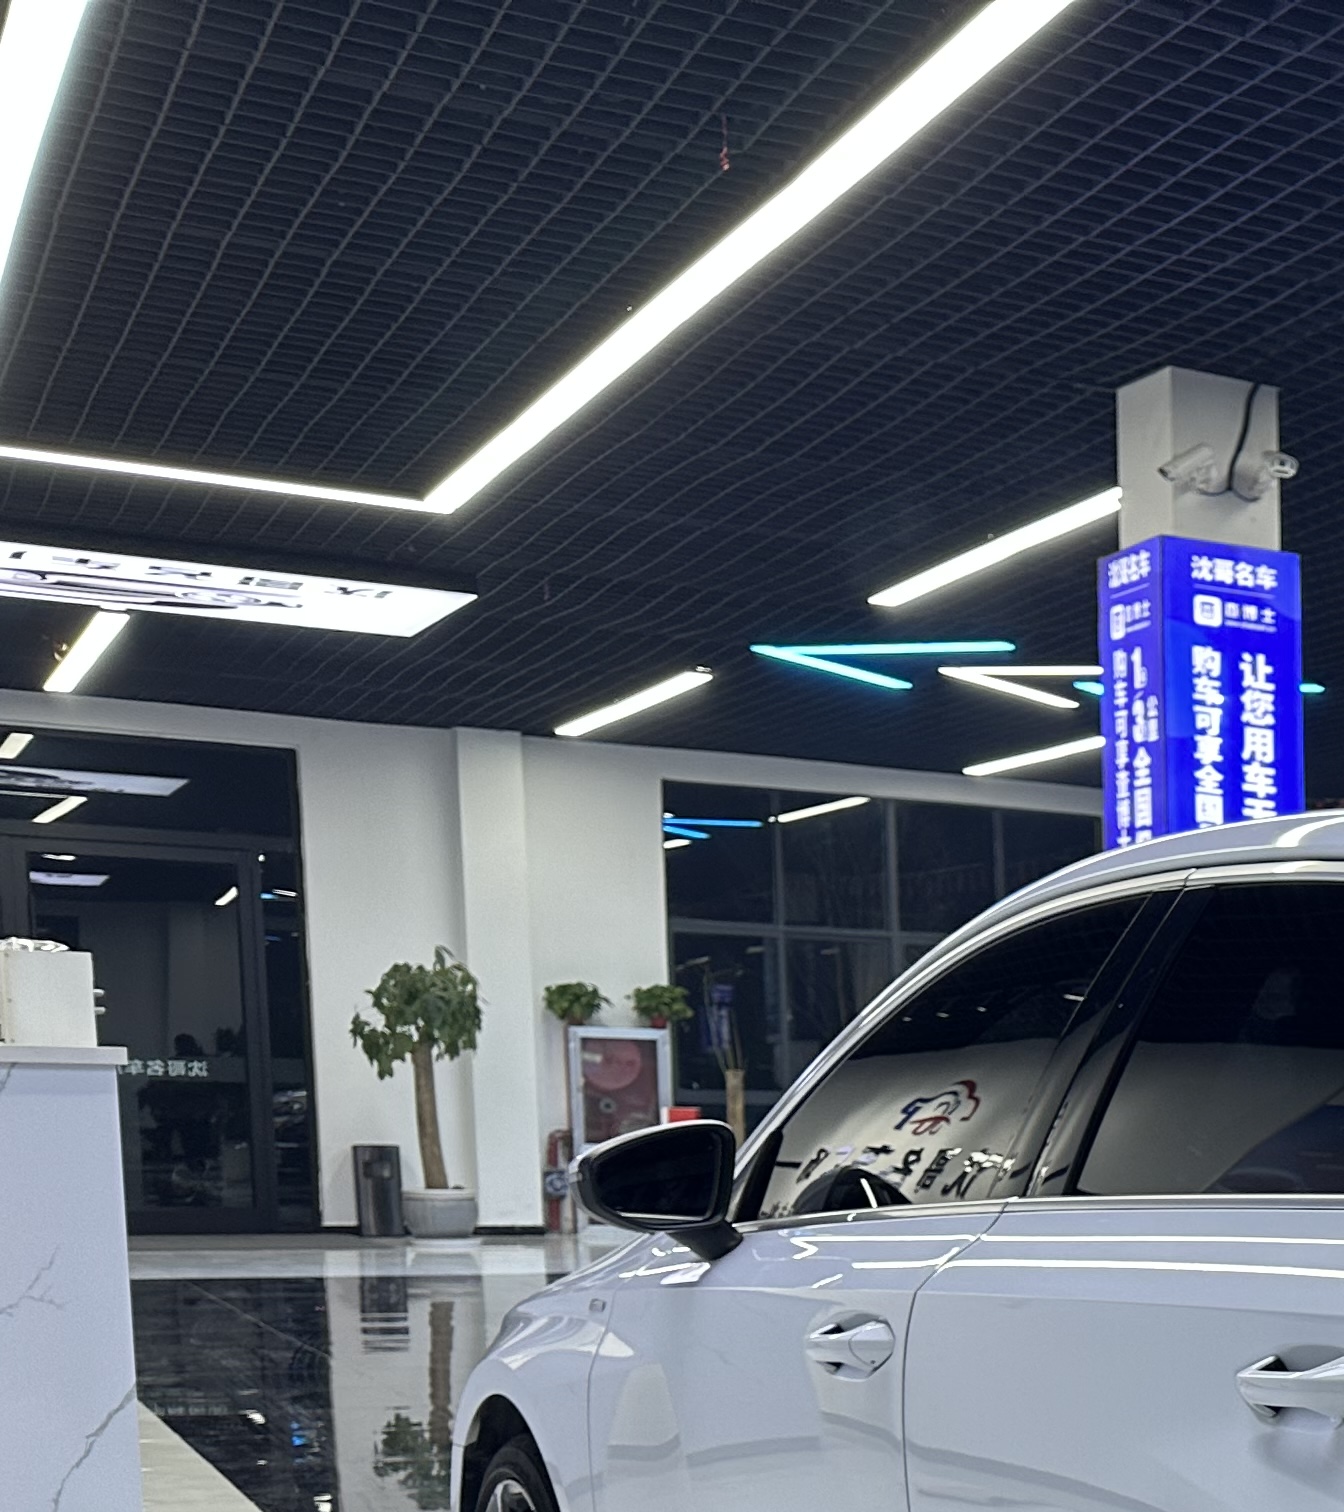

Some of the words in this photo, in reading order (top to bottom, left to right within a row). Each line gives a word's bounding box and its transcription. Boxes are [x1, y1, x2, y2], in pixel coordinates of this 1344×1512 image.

[1191, 645, 1225, 829] 购车可享全国
